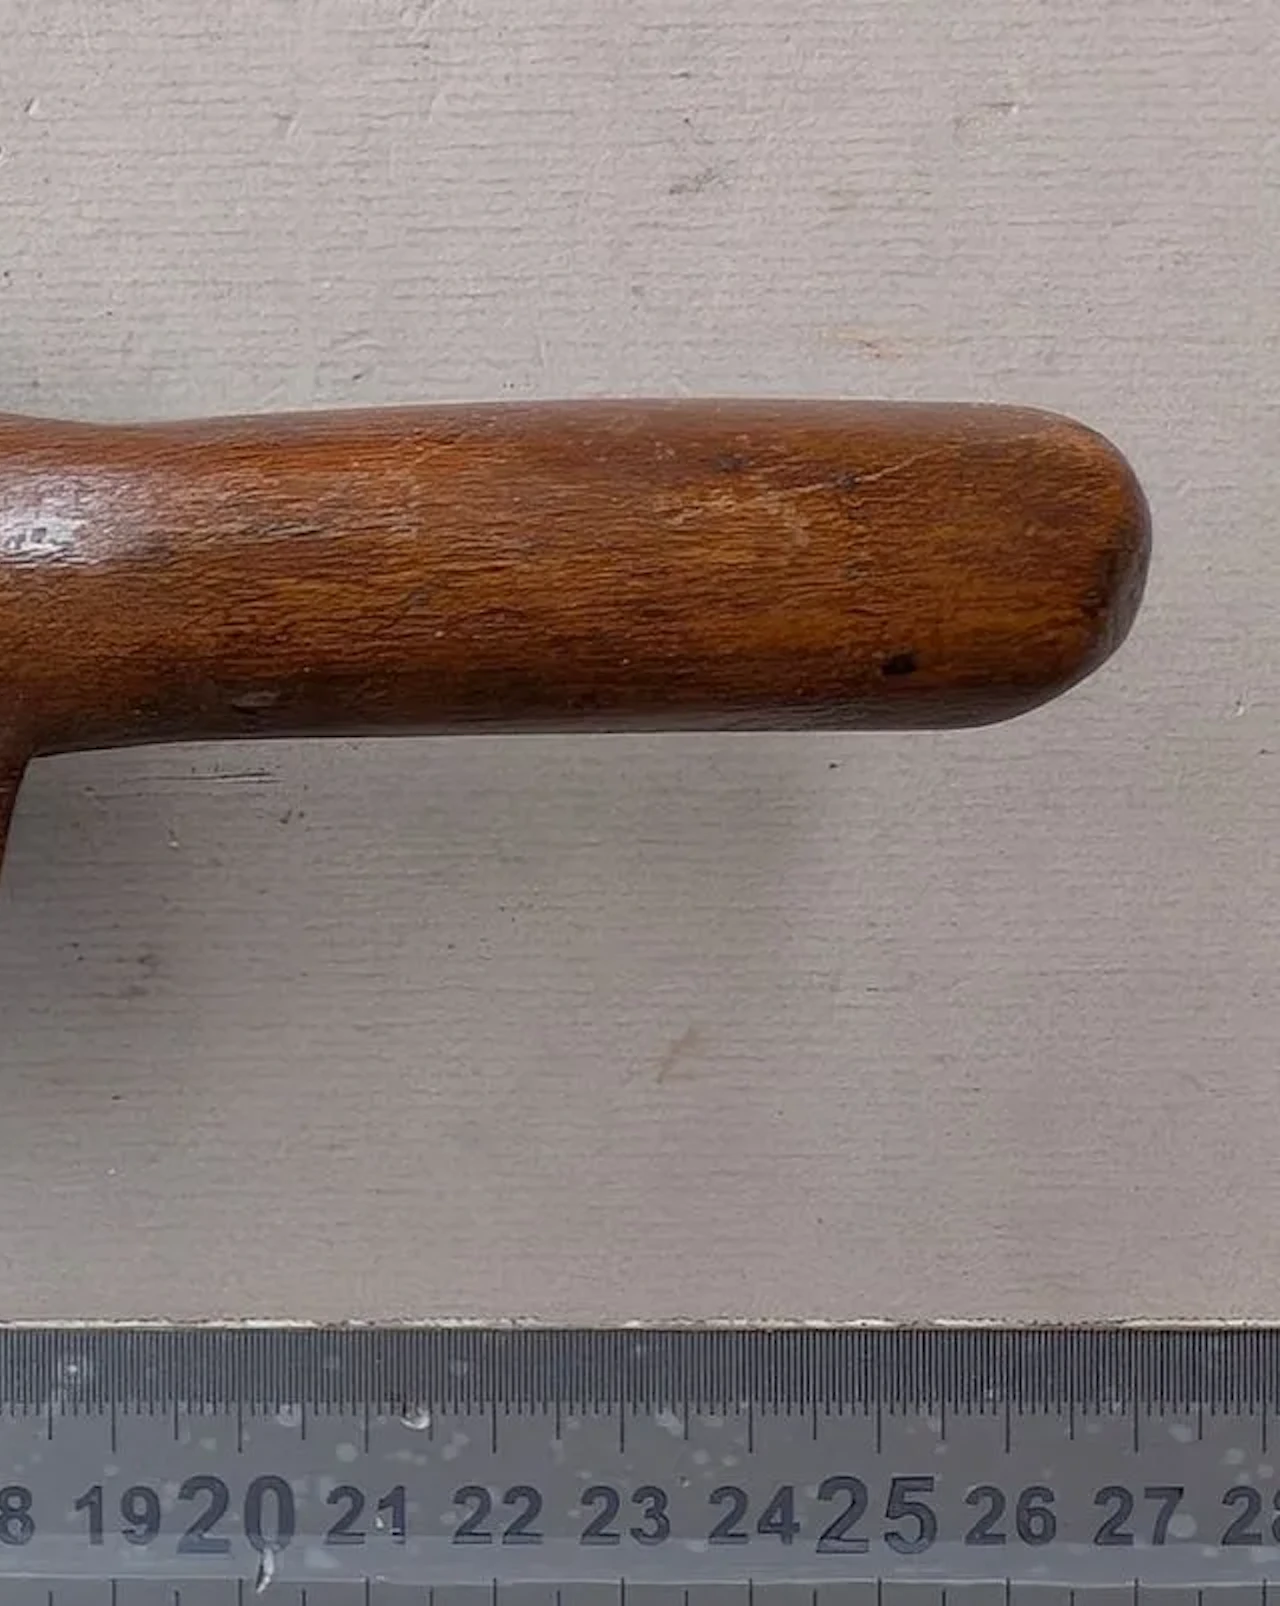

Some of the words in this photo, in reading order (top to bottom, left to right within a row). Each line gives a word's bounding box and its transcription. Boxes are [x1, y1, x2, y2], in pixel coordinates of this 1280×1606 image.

[76, 1487, 161, 1546] 19
[180, 1476, 295, 1555] 20
[328, 1486, 405, 1546] 21
[454, 1486, 542, 1545] 22
[582, 1486, 670, 1545] 23
[709, 1486, 800, 1545] 24
[818, 1476, 937, 1553] 25
[966, 1486, 1056, 1544] 26
[1094, 1486, 1184, 1544] 27
[1221, 1486, 1280, 1546] 2
